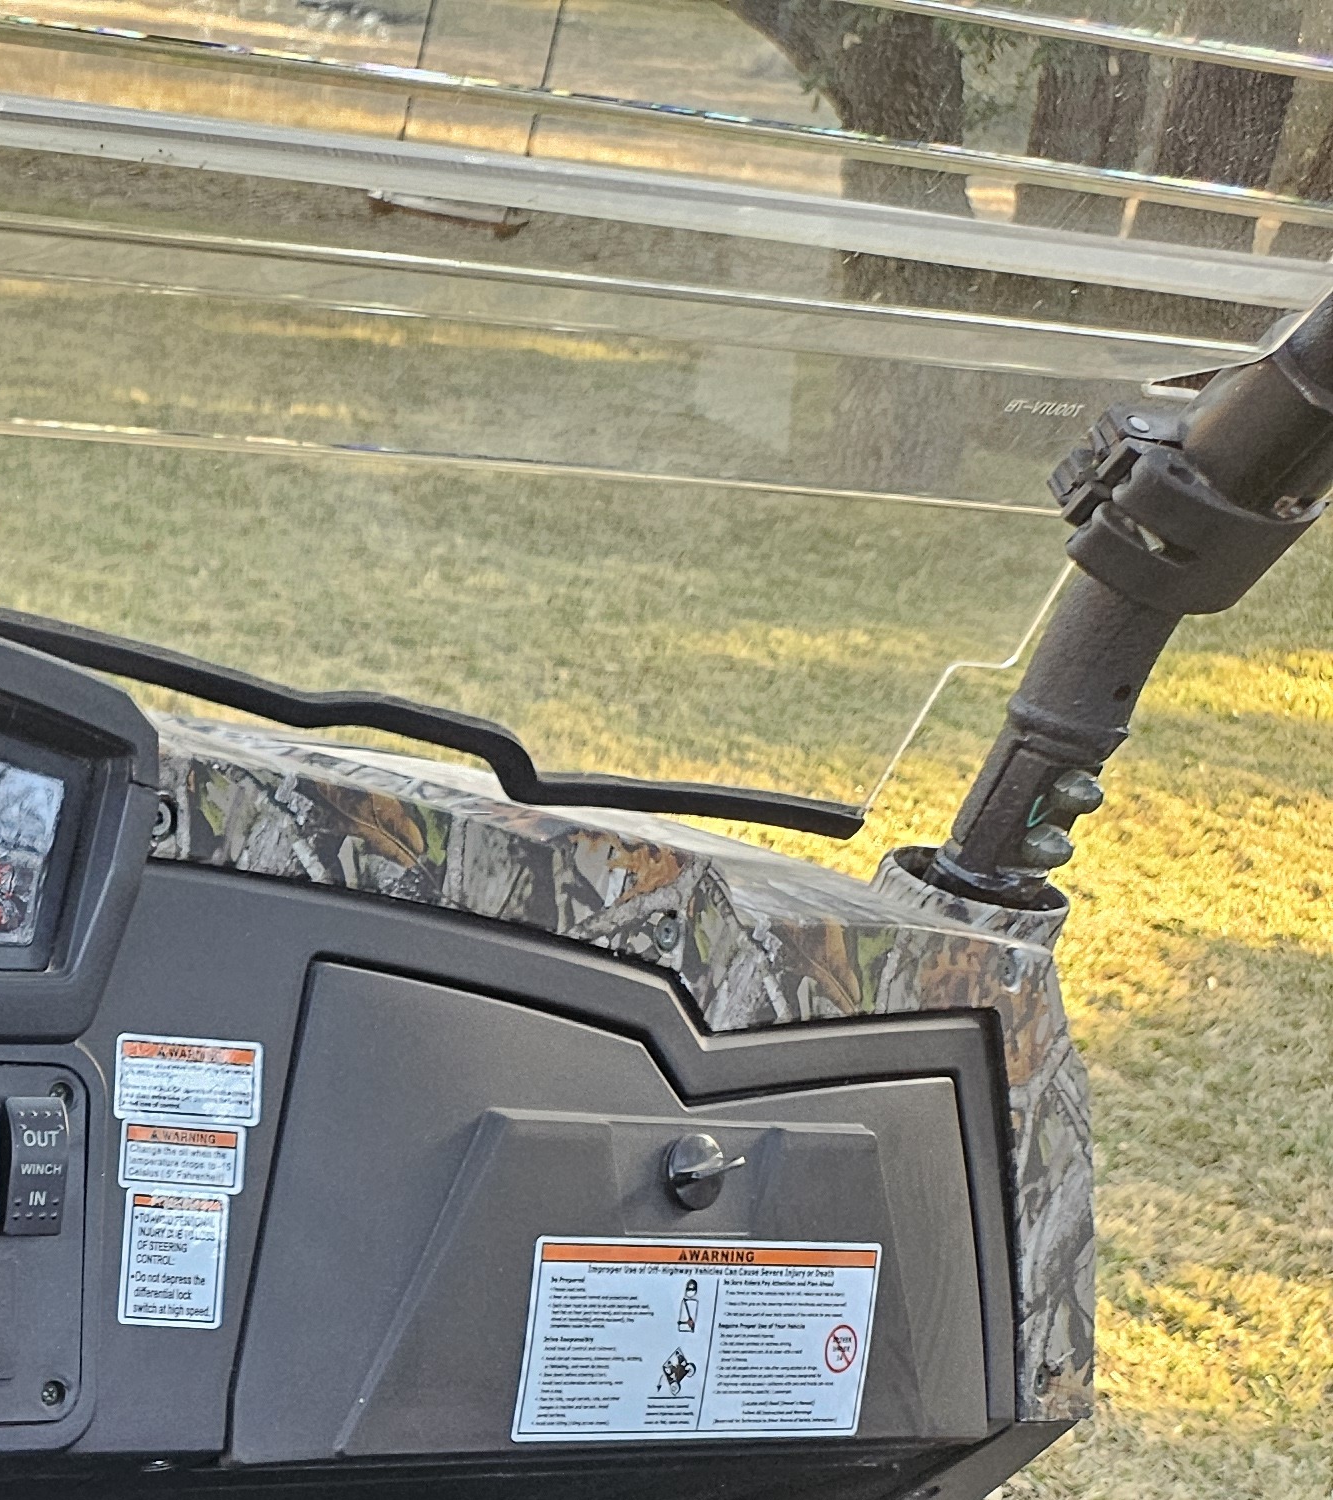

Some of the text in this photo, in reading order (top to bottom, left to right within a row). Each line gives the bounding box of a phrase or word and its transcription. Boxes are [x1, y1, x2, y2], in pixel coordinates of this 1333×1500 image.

[22, 1130, 58, 1147] OUT
[162, 1130, 216, 1144] WARNING
[130, 1144, 161, 1156] Change
[191, 1150, 211, 1158] when
[214, 1151, 226, 1159] the
[129, 1156, 178, 1166] temperature
[181, 1160, 205, 1169] drops
[21, 1164, 62, 1175] WINCH
[129, 1167, 158, 1178] Celsius
[28, 1191, 46, 1205] IN
[138, 1227, 165, 1237] INJURY
[137, 1240, 187, 1253] OF STEERING
[689, 1250, 755, 1263] WARNING
[135, 1271, 206, 1286] Do not depress the
[588, 1265, 623, 1275] Improper
[624, 1266, 636, 1274] Use
[638, 1266, 645, 1274] of
[694, 1268, 723, 1276] Vehicles
[724, 1268, 738, 1276] Can
[739, 1268, 759, 1276] Cause
[761, 1269, 784, 1277] Severe
[784, 1269, 805, 1279] Injury
[815, 1269, 834, 1277] Death
[134, 1287, 192, 1300] differential lock
[133, 1303, 157, 1313] switch
[159, 1304, 167, 1314] at
[168, 1304, 184, 1317] high
